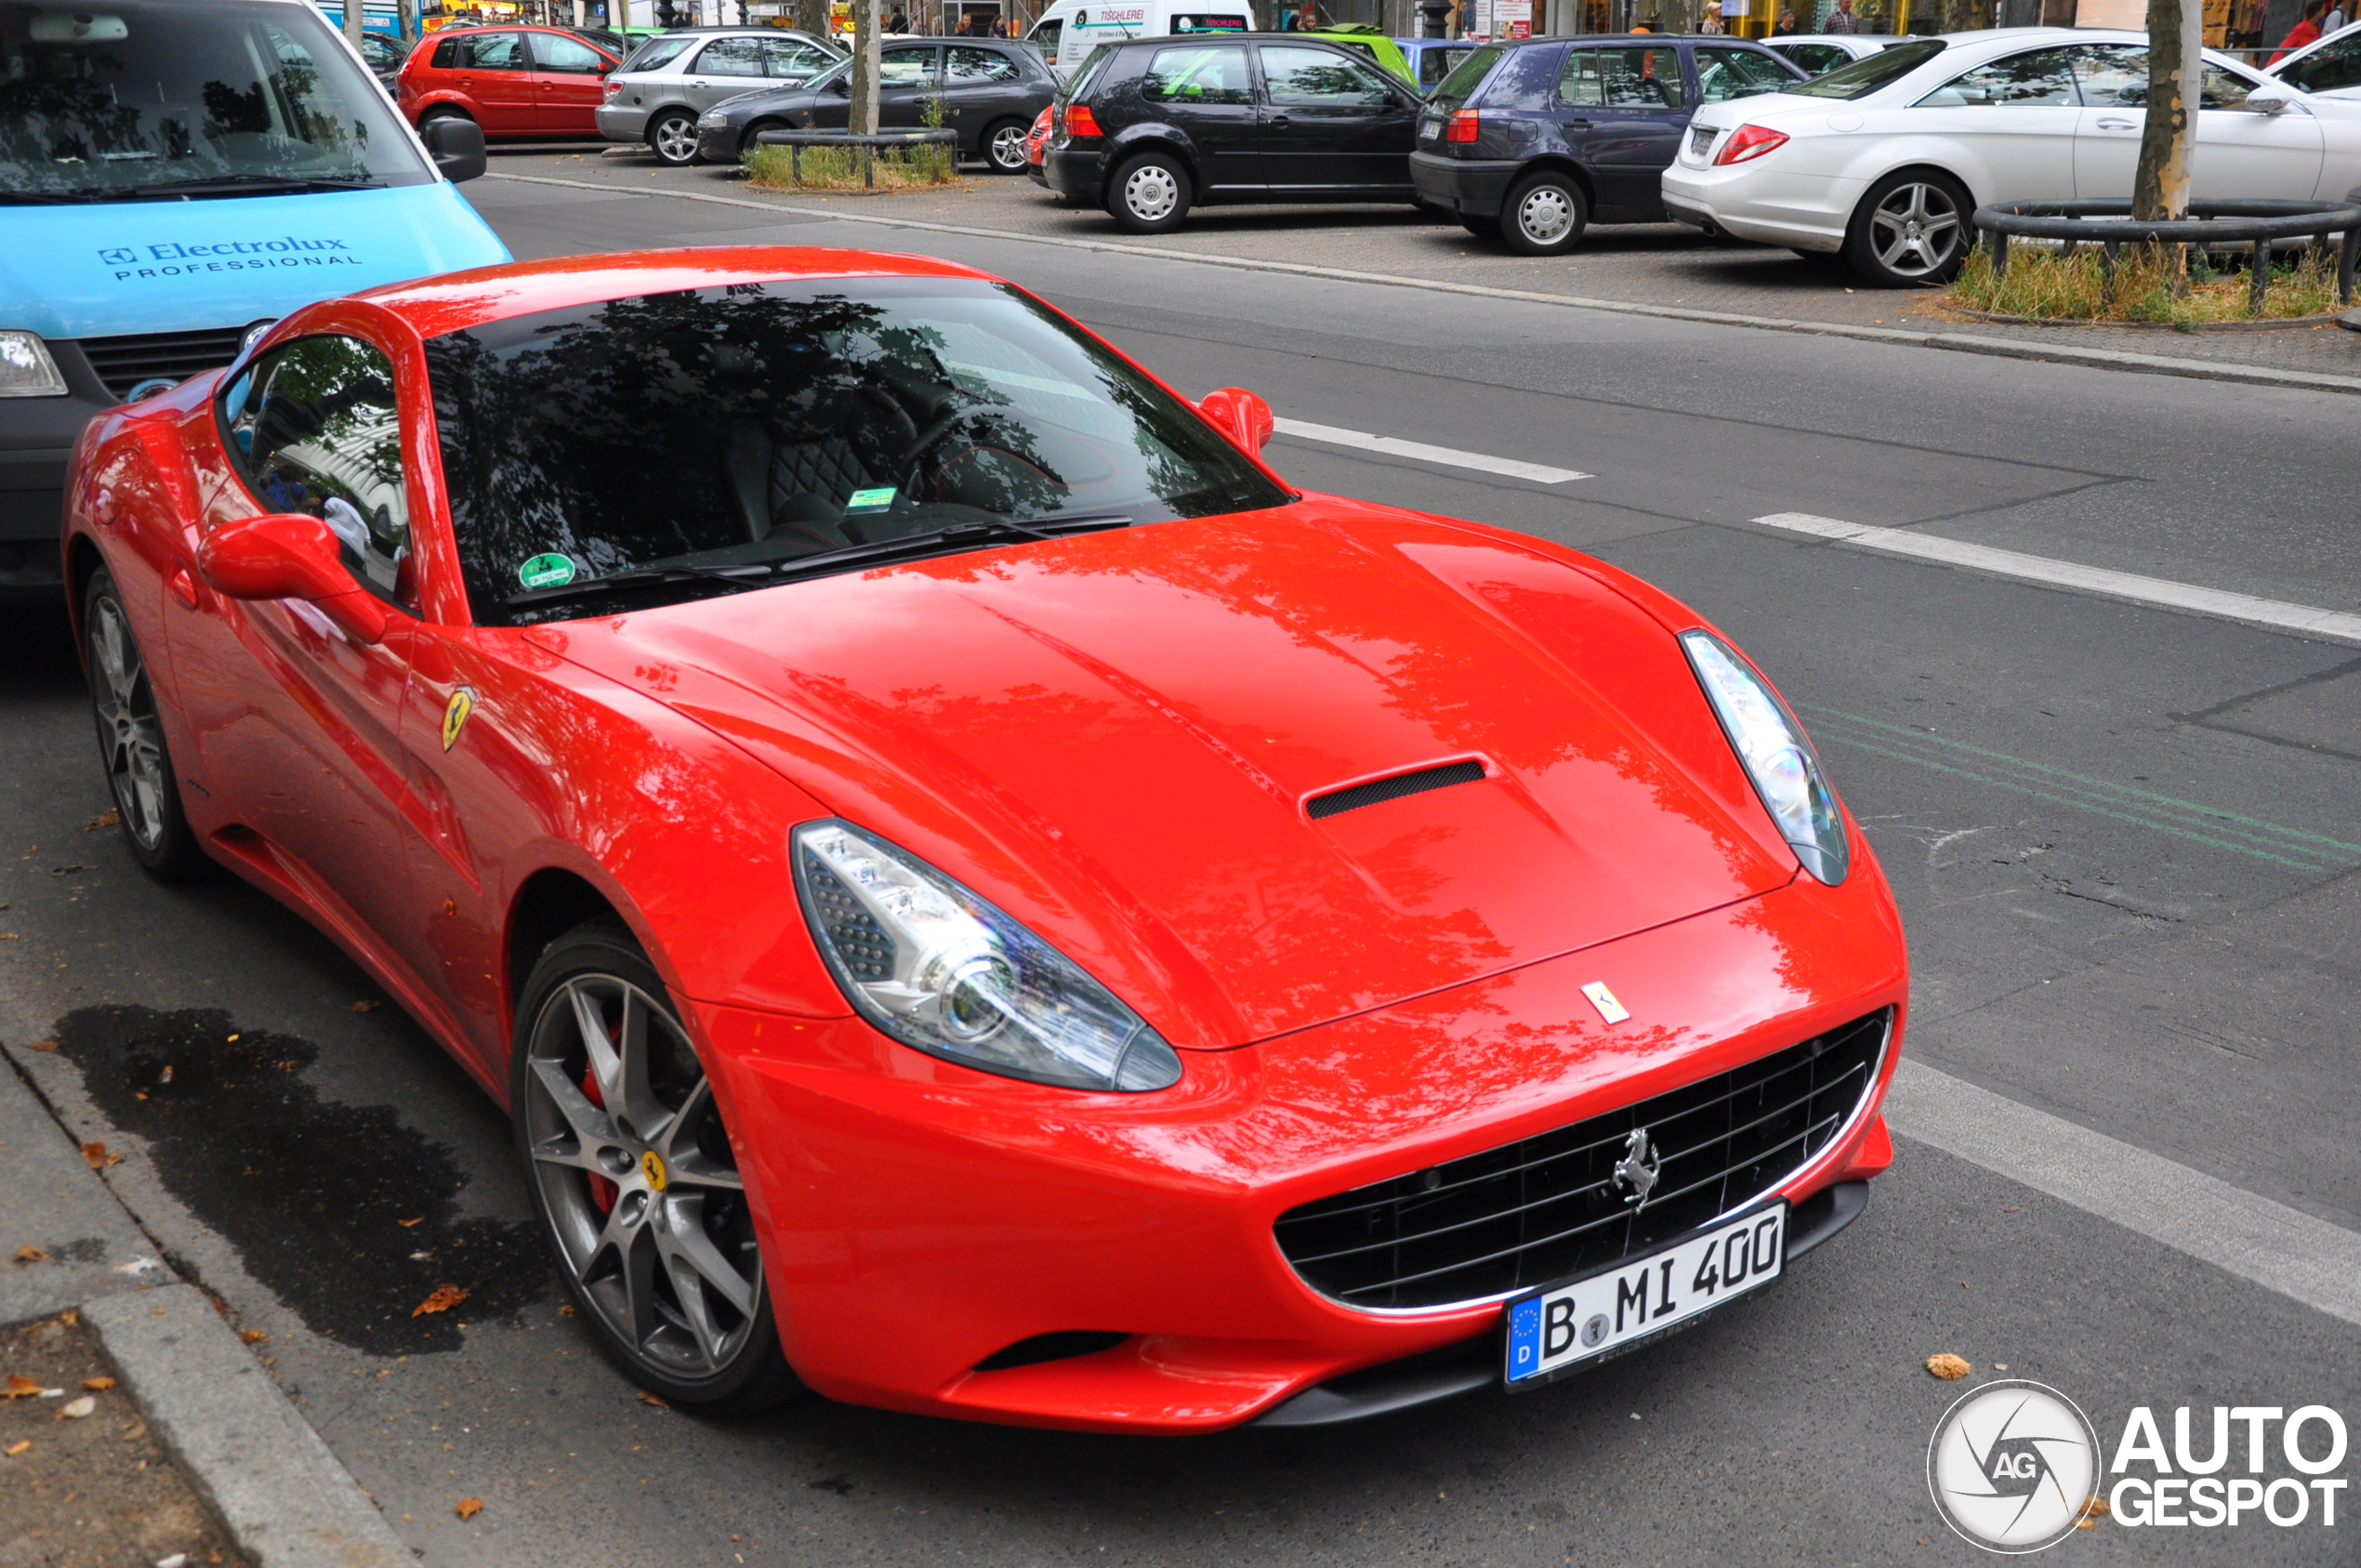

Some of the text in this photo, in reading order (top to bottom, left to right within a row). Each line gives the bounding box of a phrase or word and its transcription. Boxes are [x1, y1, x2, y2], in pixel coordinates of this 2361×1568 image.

[1101, 9, 1144, 20] TISCHLEREI
[1206, 19, 1243, 27] TISCHLEREI
[145, 236, 352, 261] Electrolux
[114, 256, 363, 281] PROFESSIONAL
[1543, 1297, 1576, 1360] B
[1616, 1258, 1676, 1333] MI
[1692, 1215, 1777, 1298] 400
[1598, 1311, 1711, 1364] SCUDERIA BERLIN
[1518, 1346, 1530, 1364] D
